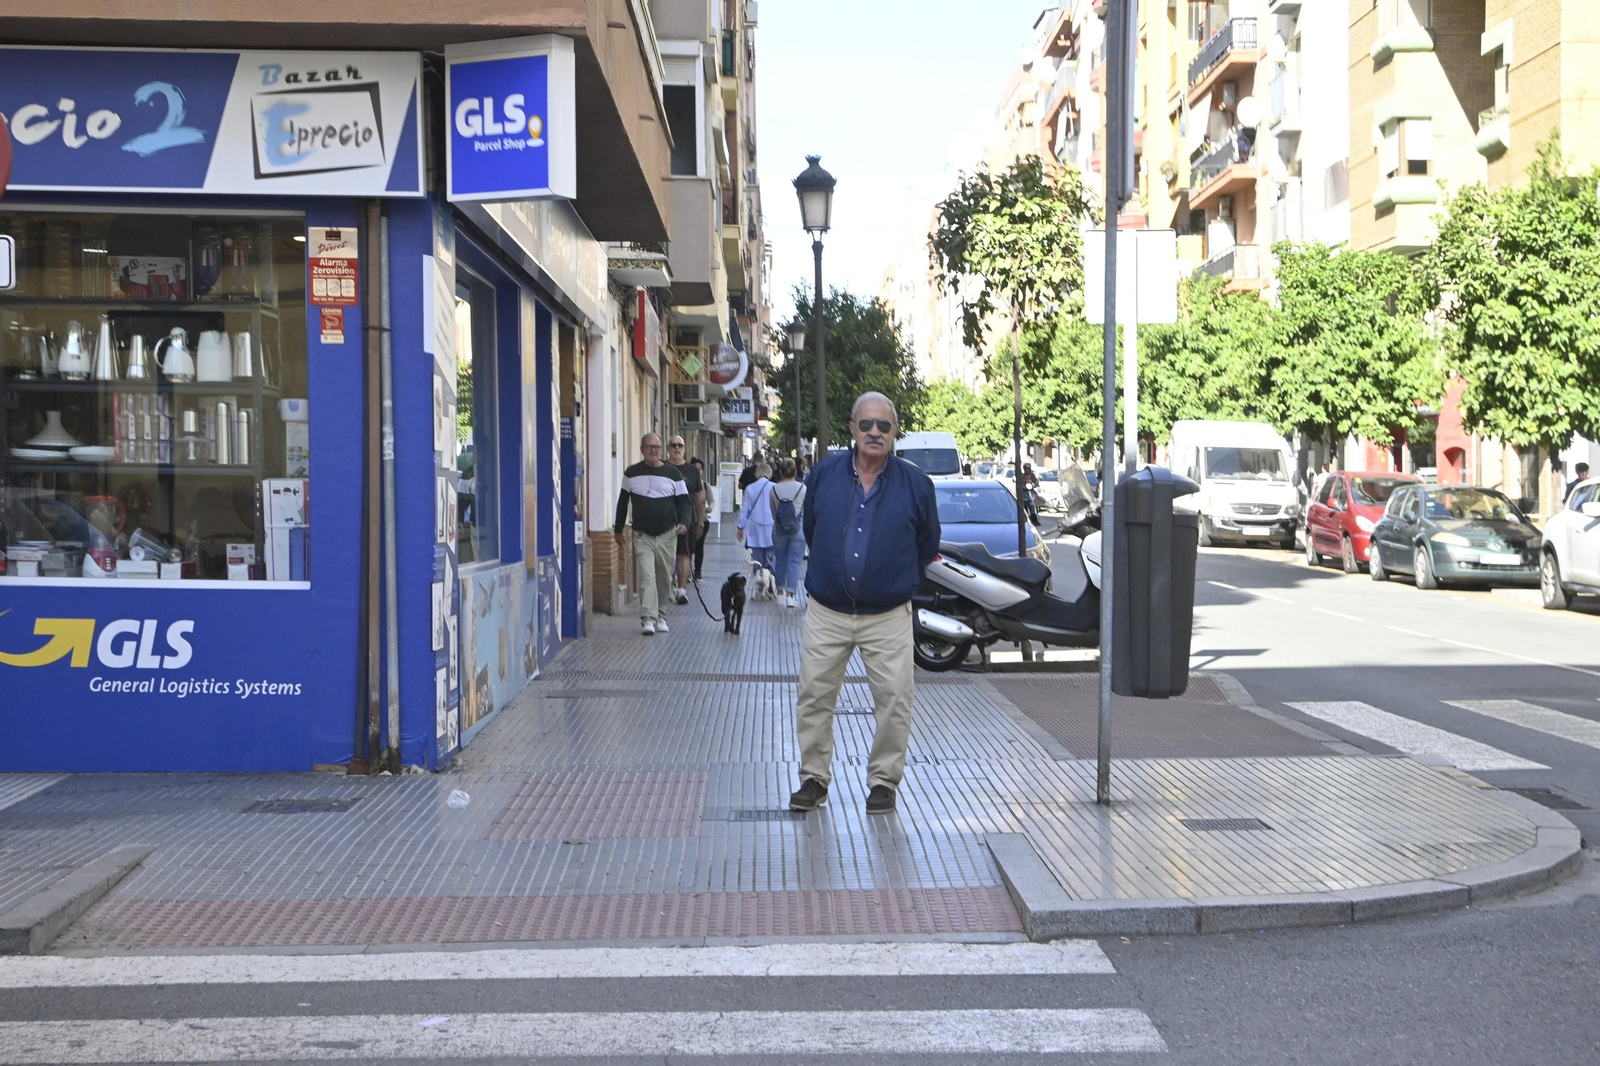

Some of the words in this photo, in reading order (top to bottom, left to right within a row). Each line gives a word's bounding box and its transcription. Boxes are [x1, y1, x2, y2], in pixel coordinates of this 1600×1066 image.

[258, 64, 363, 86] Bazar
[0, 97, 122, 150] cio
[120, 80, 207, 158] 2
[455, 93, 527, 138] GLS
[474, 138, 502, 152] Parcel
[503, 137, 526, 152] Shop
[313, 266, 355, 275] Zerovision
[320, 259, 348, 267] Alarma
[96, 618, 195, 669] GLS
[89, 676, 155, 693] General
[159, 677, 230, 698] Logistics
[234, 678, 302, 699] Systems
